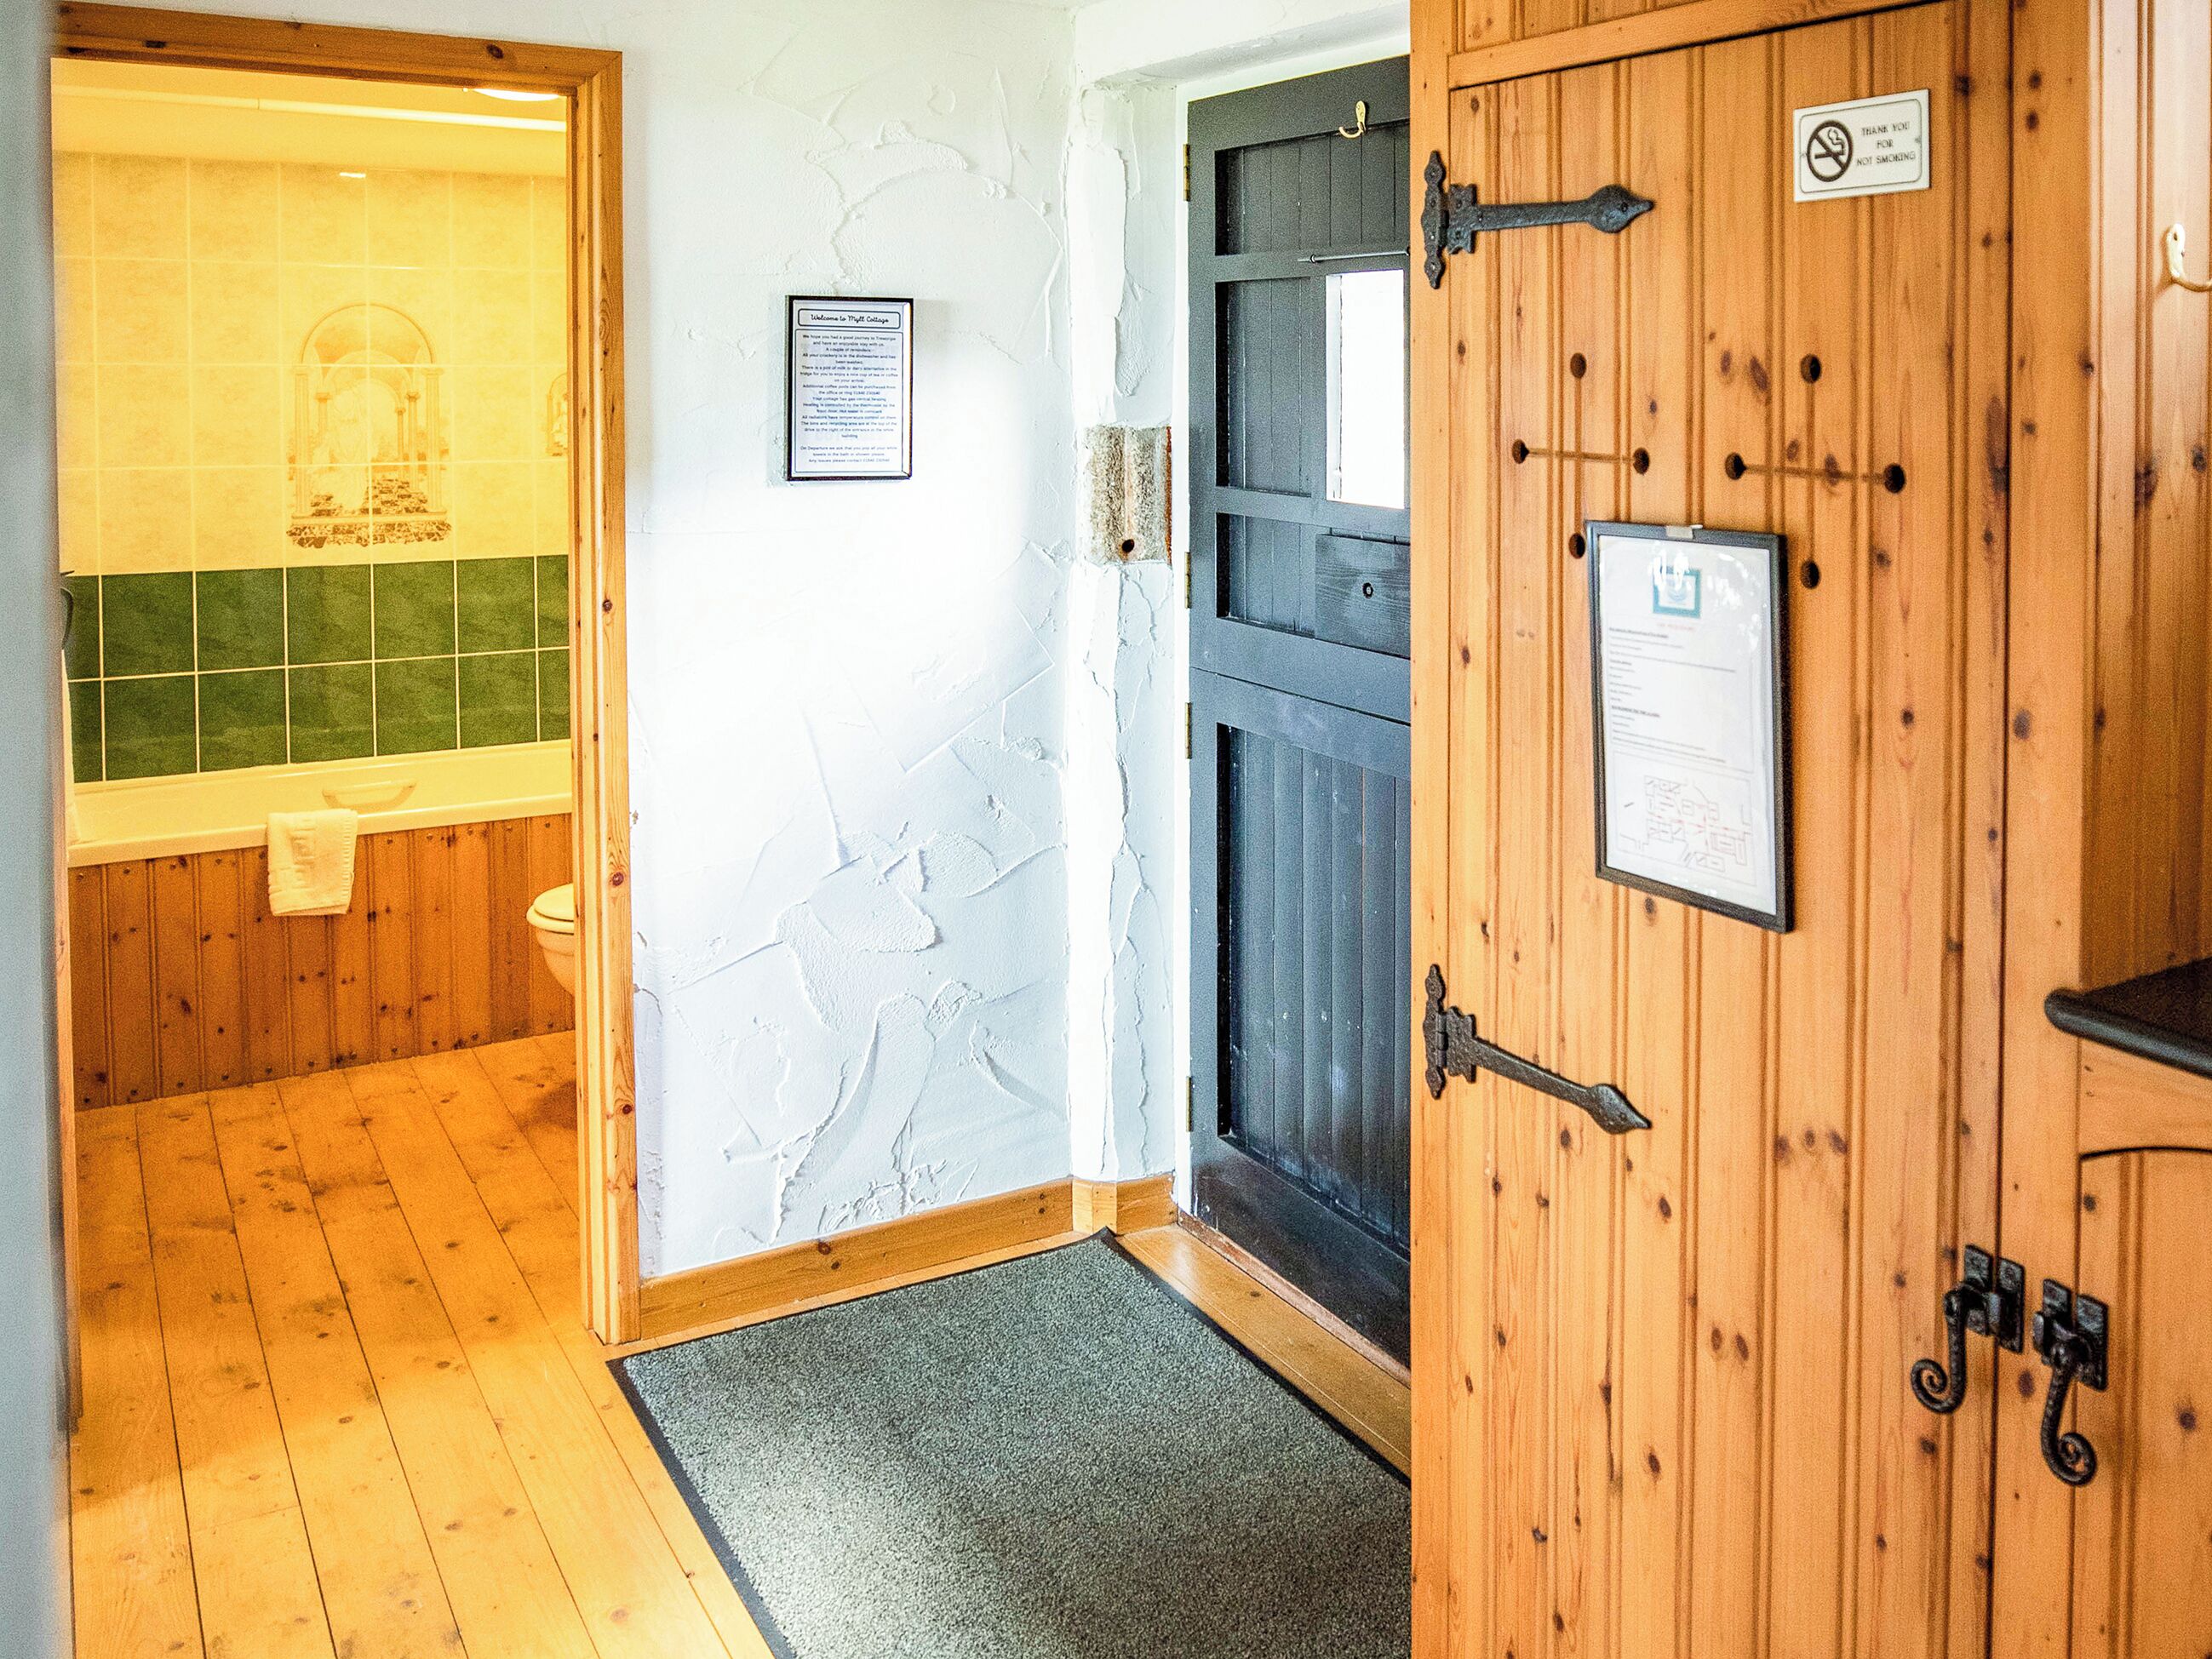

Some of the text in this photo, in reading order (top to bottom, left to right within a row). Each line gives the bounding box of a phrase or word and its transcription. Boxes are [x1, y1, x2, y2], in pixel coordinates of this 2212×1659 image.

[1861, 122, 1911, 136] THANK YOU
[1876, 139, 1894, 149] FOR
[1856, 151, 1916, 166] NOT SMOKING
[866, 316, 888, 324] Cottage
